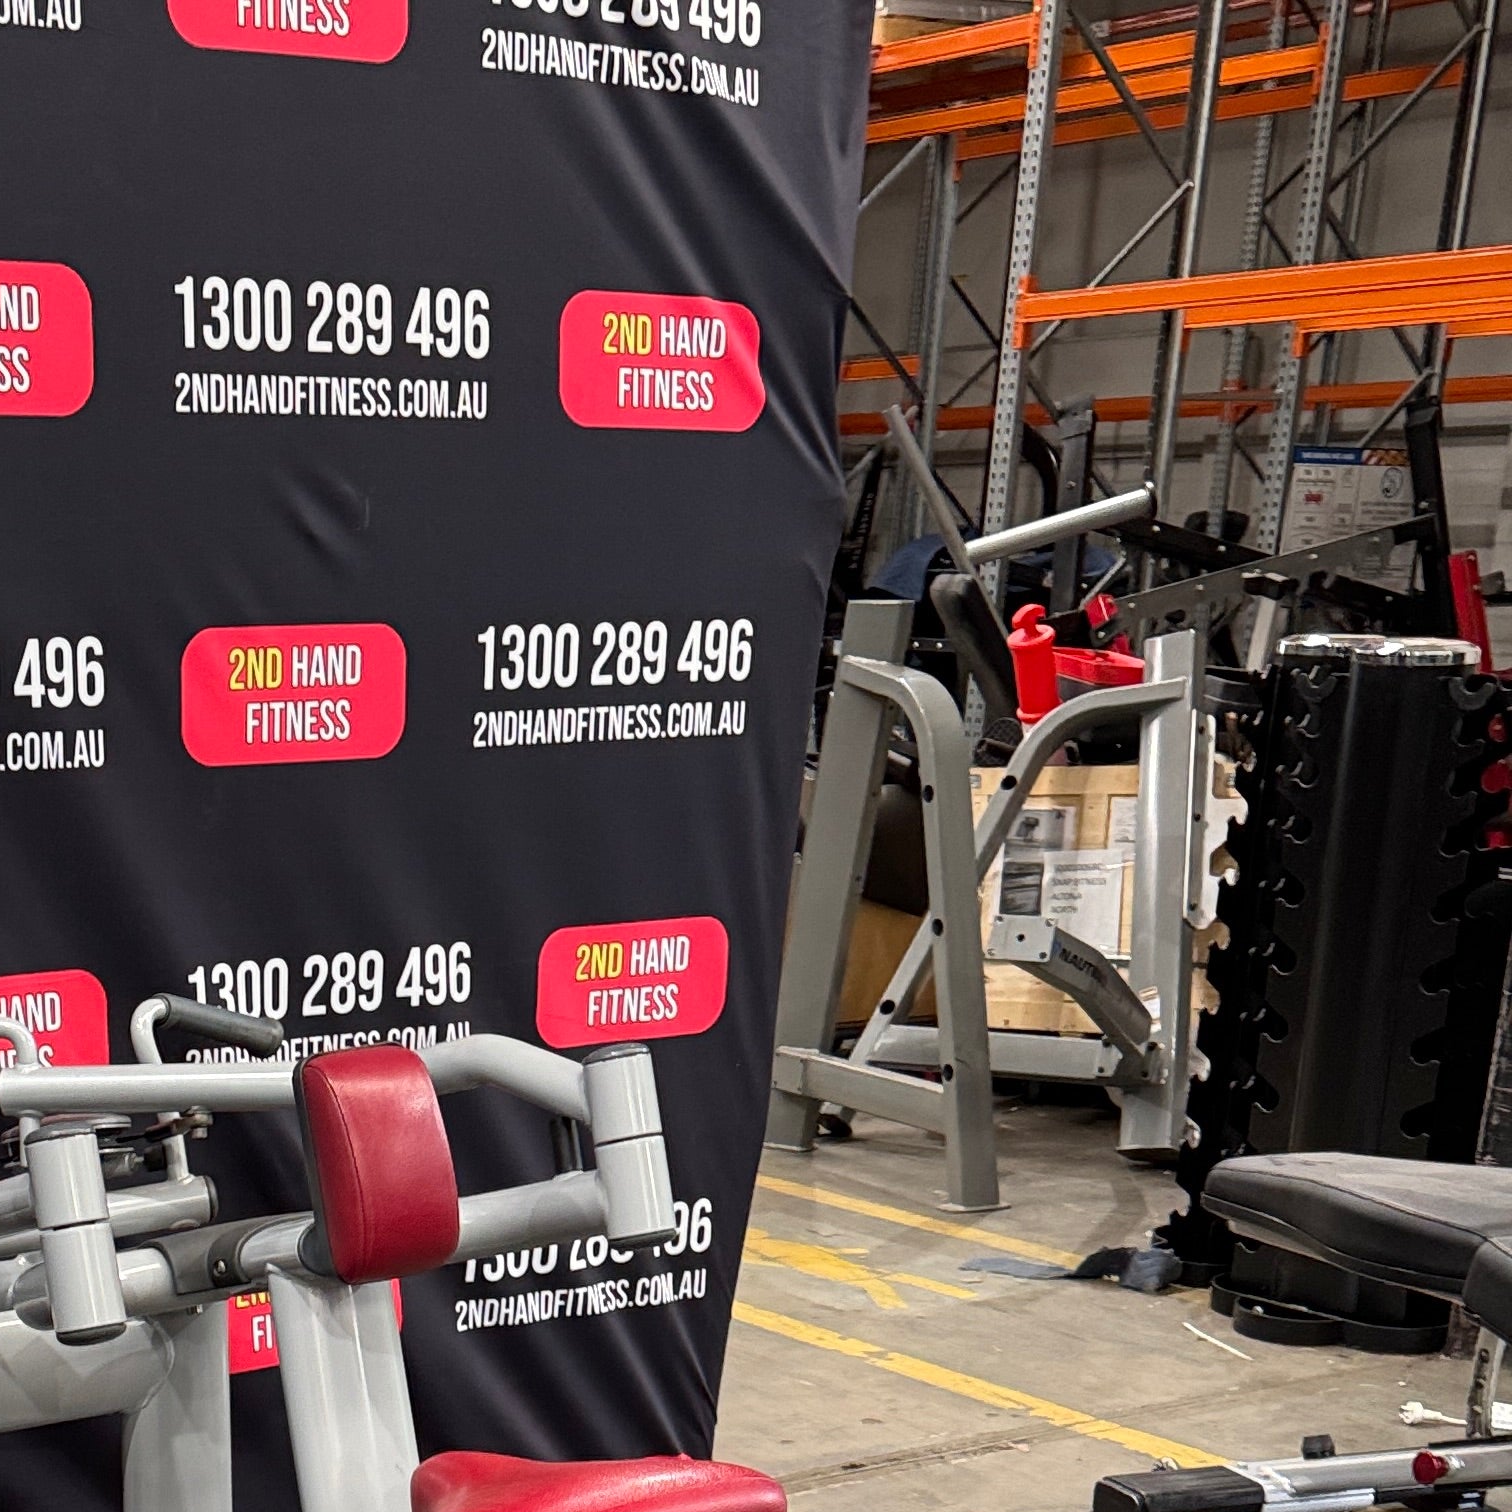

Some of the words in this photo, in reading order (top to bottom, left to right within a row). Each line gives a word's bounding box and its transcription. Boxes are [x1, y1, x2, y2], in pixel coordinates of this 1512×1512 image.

[481, 27, 760, 107] 2NDHANDFITNESS.COM.AU
[174, 275, 292, 353] 1300
[306, 280, 393, 356] 289
[405, 286, 490, 360] 496
[603, 312, 652, 355] 2ND
[660, 315, 727, 358] HAND
[174, 372, 488, 420] 2NDHANDFITNESS.COM.AU
[618, 367, 714, 412] FITNESS
[13, 635, 105, 709] 496
[229, 647, 283, 690] 2ND
[291, 644, 362, 688] HAND
[477, 622, 580, 691] 1300
[590, 620, 668, 686] 289
[676, 618, 754, 683] 496
[246, 699, 351, 744] FITNESS
[472, 700, 746, 748] 2NDHANDFITNESS.COM.AU
[302, 949, 384, 1017] 289
[395, 941, 472, 1007] 496
[575, 942, 624, 981] 2ND
[630, 935, 690, 976] HAND
[587, 983, 679, 1026] FITNESS
[651, 1197, 713, 1258] 96
[454, 1267, 707, 1333] 2NDHANDFITNESS.COM.AU
